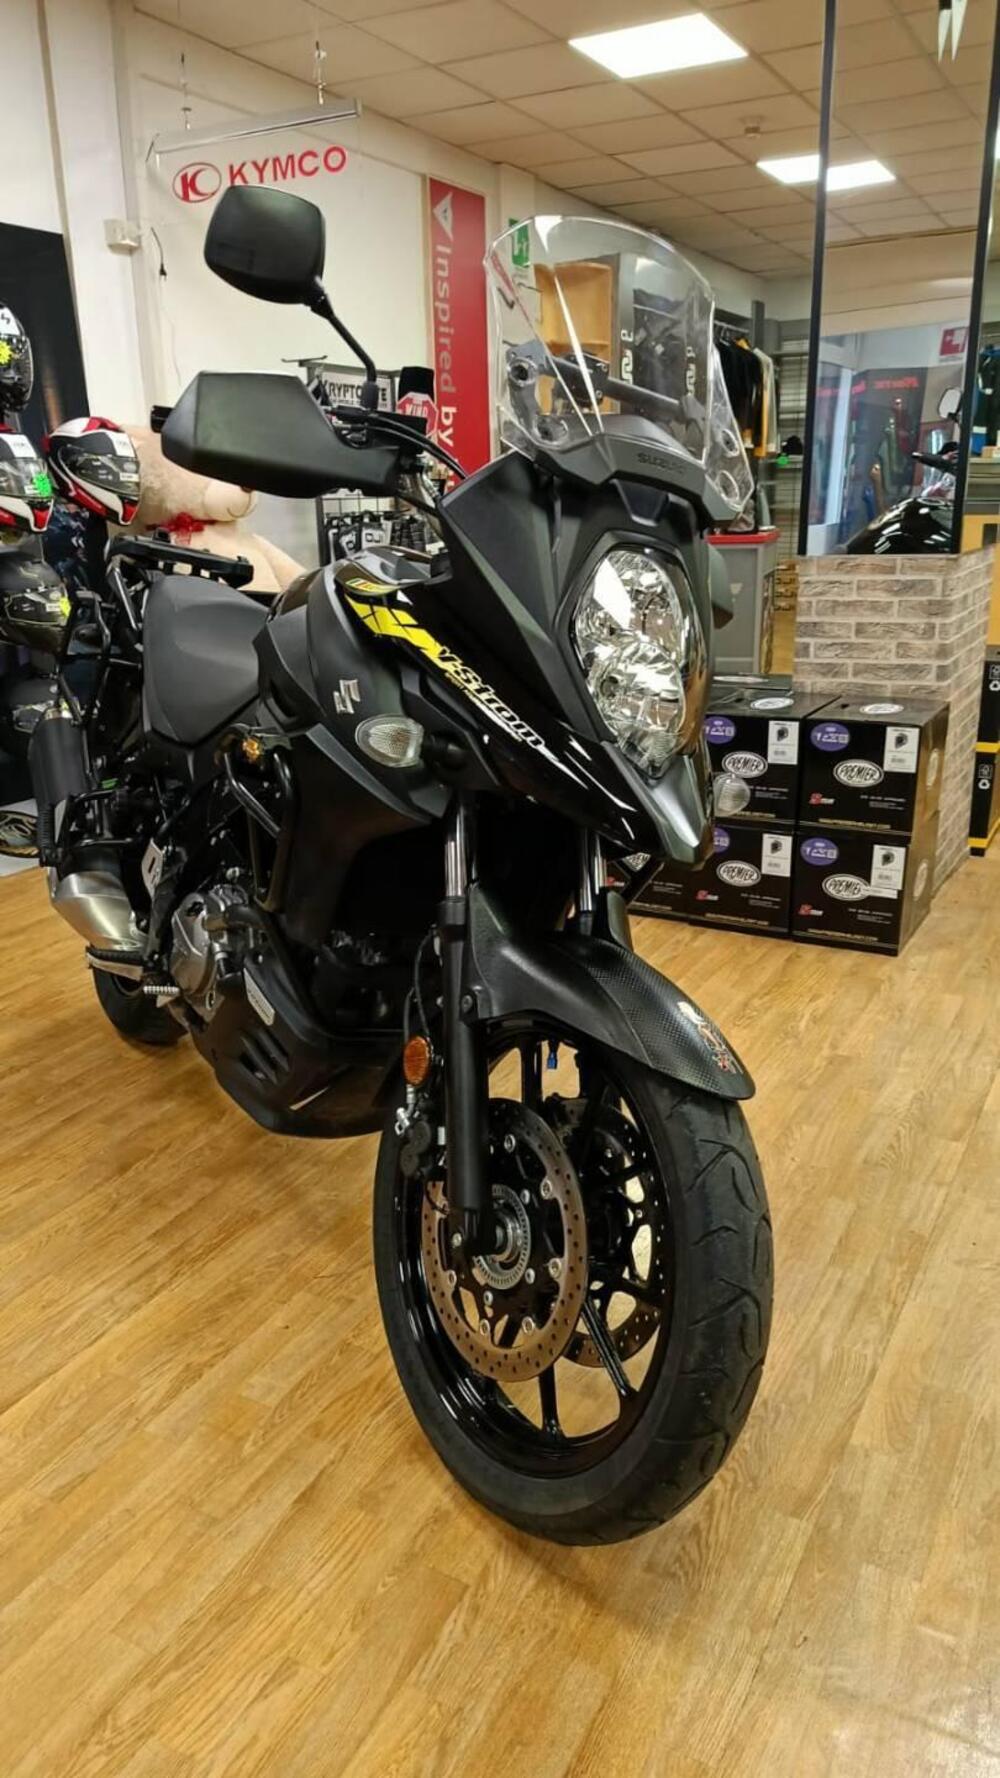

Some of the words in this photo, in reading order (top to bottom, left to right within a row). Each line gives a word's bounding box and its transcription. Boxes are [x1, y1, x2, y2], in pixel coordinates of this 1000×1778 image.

[229, 146, 346, 187] KYMCO
[436, 245, 456, 393] Inspired
[439, 405, 457, 447] by
[439, 645, 546, 749] V-Strom
[838, 764, 879, 782] PREMIER
[722, 865, 757, 882] PREMIER
[827, 879, 861, 896] PREMIE
